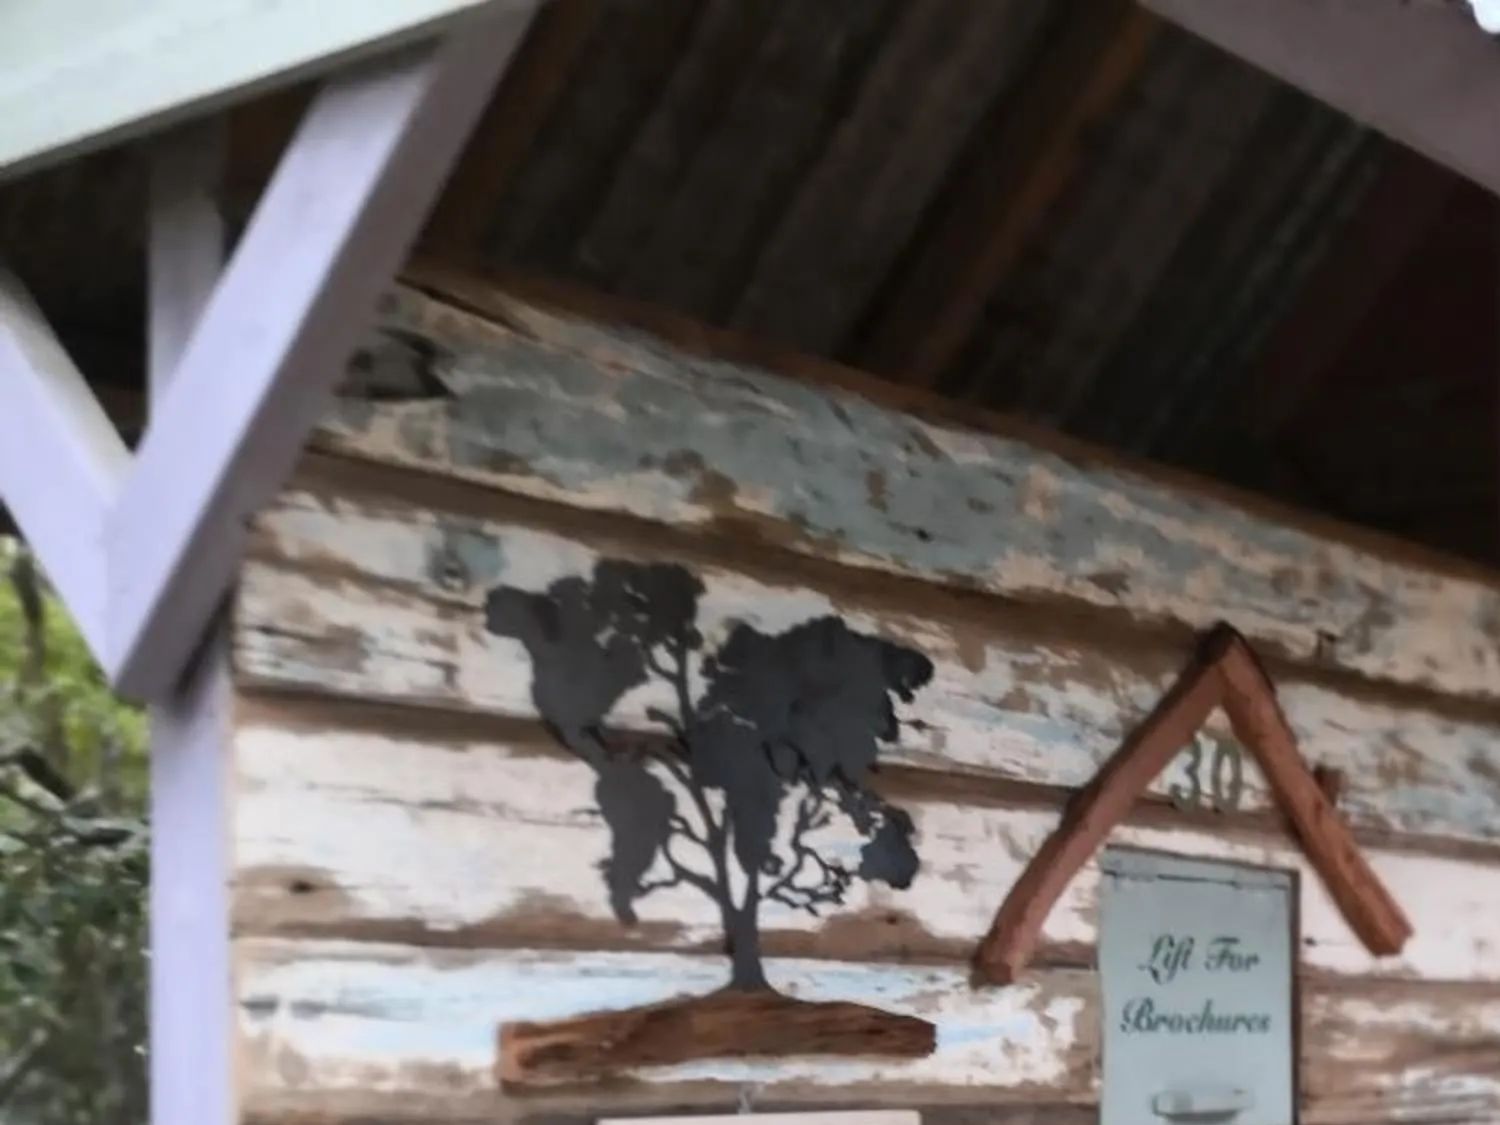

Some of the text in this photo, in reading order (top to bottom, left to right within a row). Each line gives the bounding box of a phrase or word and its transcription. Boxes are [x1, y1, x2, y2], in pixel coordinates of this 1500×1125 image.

[1167, 738, 1243, 813] 30
[1137, 933, 1260, 985] Lift For
[1120, 997, 1271, 1033] Brochures
